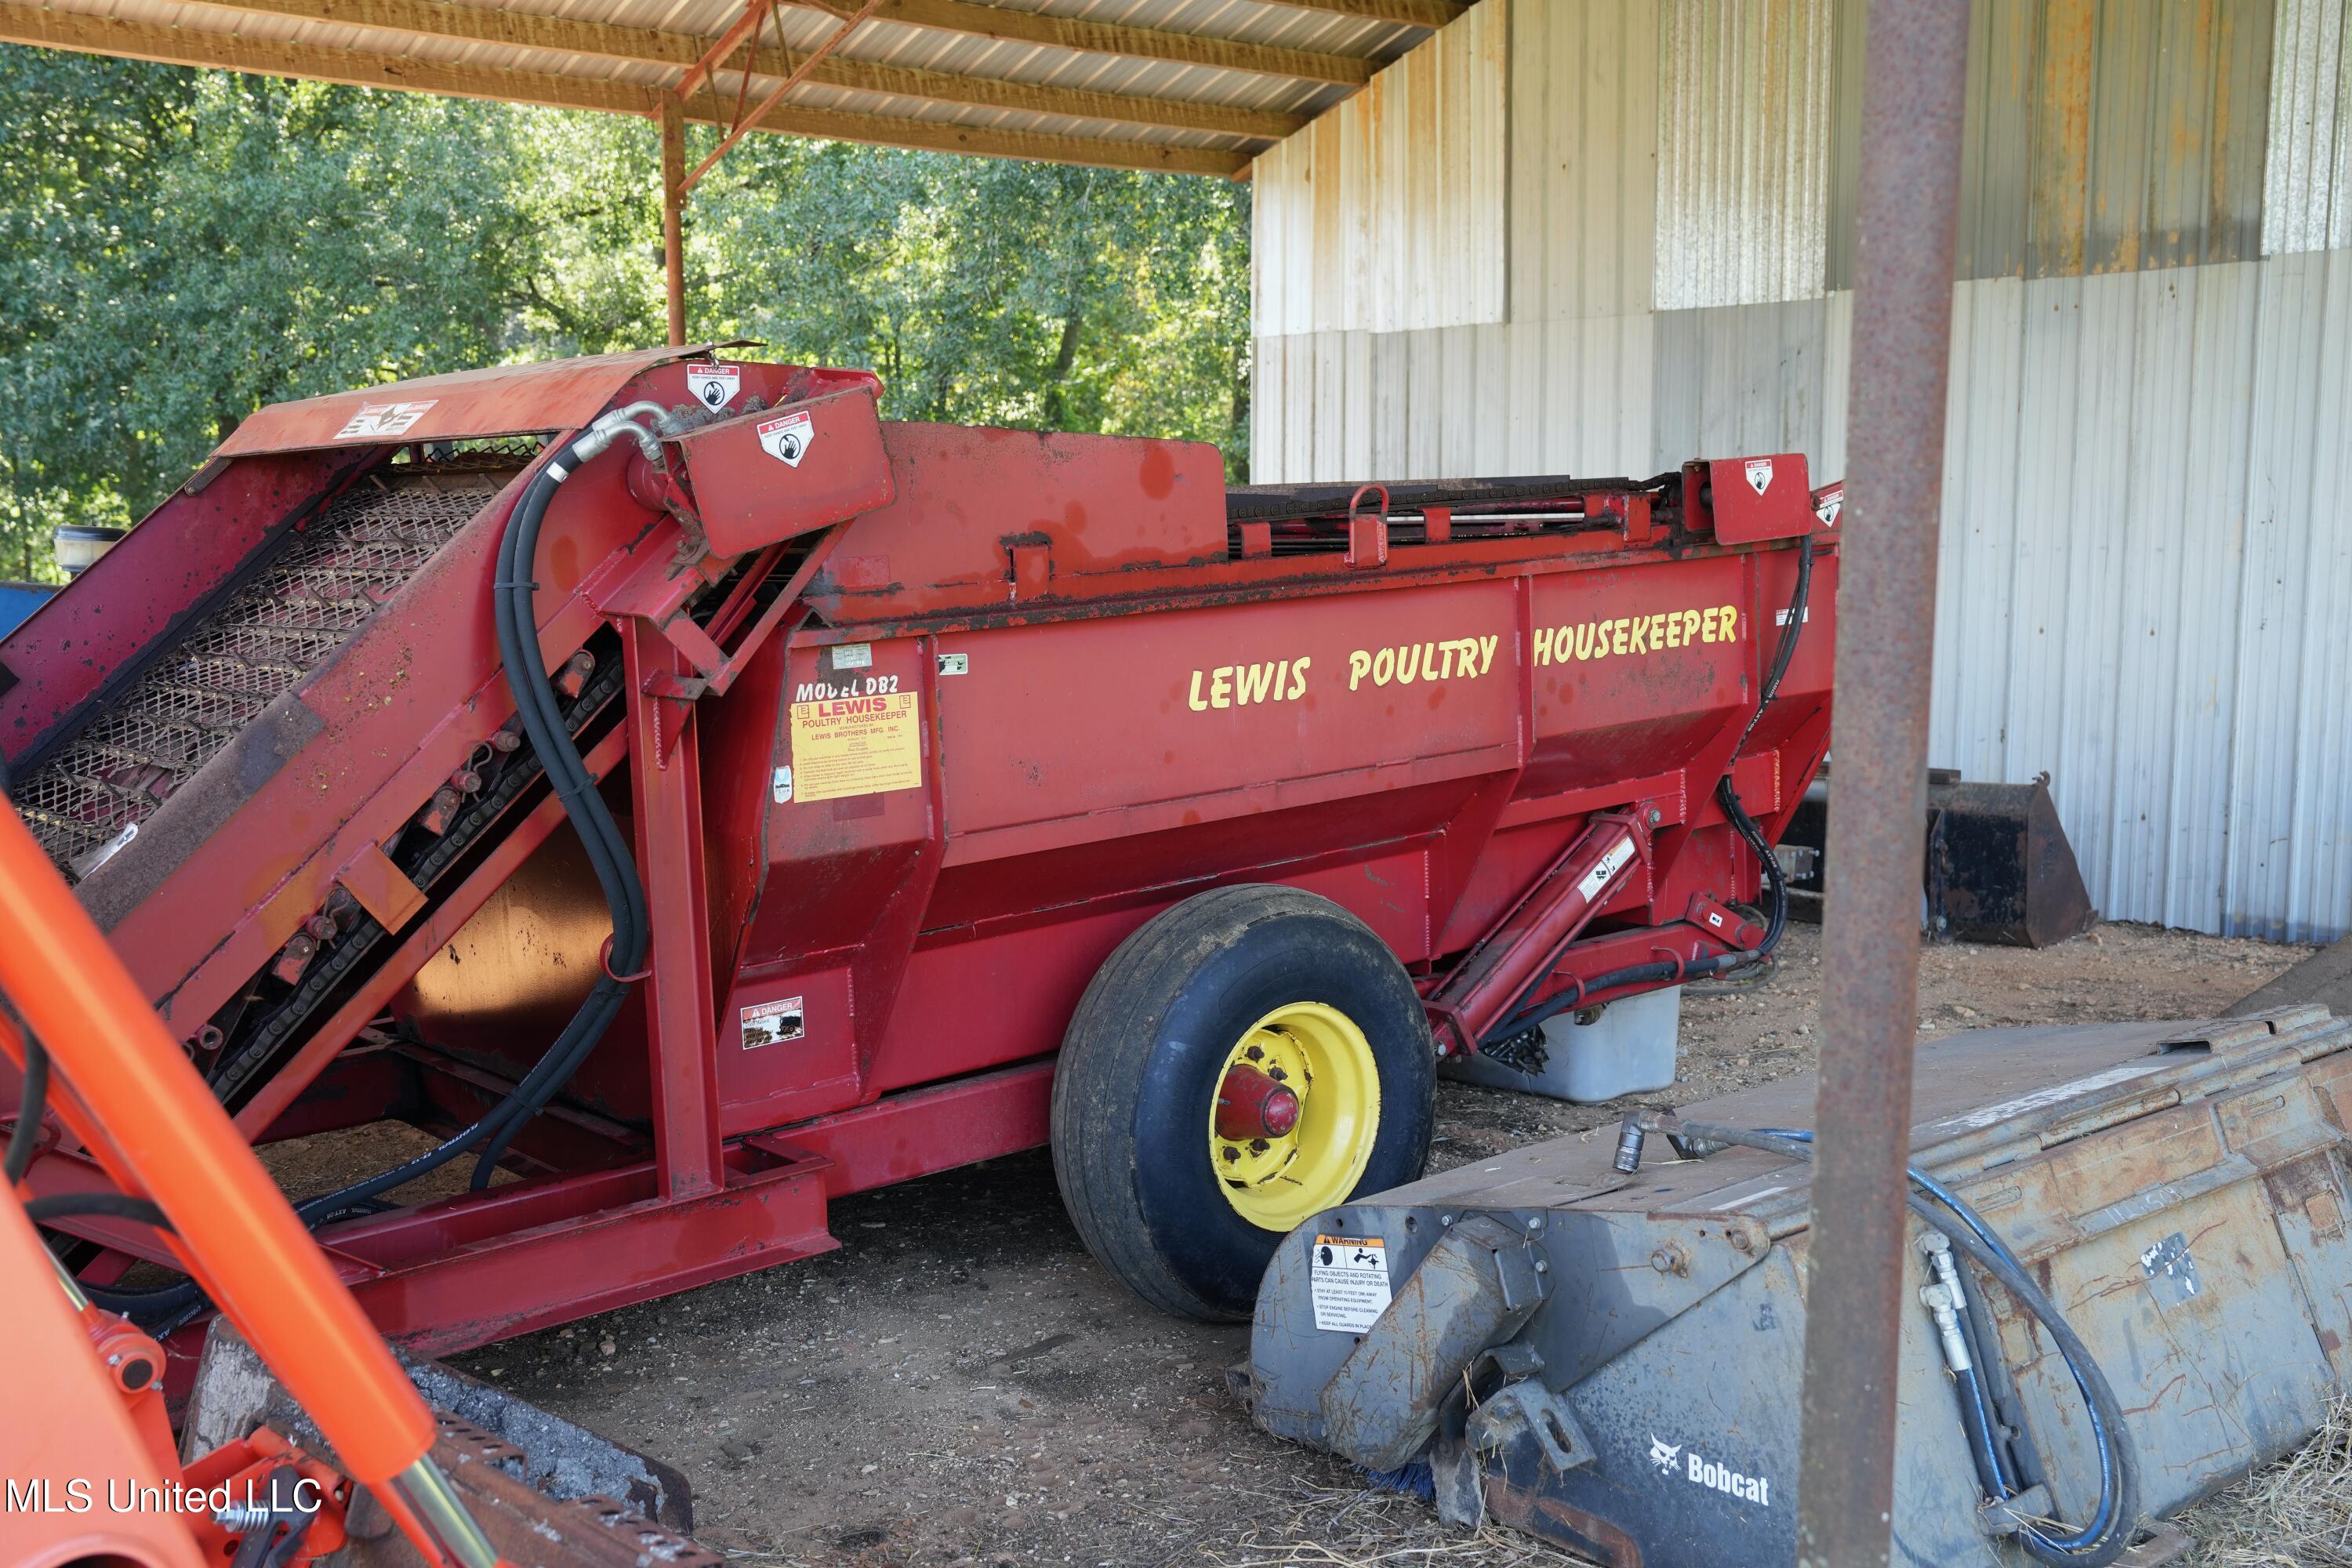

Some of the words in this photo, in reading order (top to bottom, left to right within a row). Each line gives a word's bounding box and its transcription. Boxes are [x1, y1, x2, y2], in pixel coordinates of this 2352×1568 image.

[775, 416, 800, 429] DANGER
[1188, 656, 1311, 712] LEWIS
[1348, 635, 1498, 692] POULTRY
[1534, 604, 1737, 667] HOUSEKEEPER
[866, 675, 898, 695] DB2
[818, 697, 887, 717] LEWIS
[802, 717, 842, 728] POULTRY
[846, 710, 907, 724] HOUSEKEEPER
[834, 730, 867, 739] BROTHERS
[761, 1003, 792, 1015] DANGER
[1332, 1237, 1368, 1245] WARNING
[1688, 1452, 1769, 1507] Bobcat
